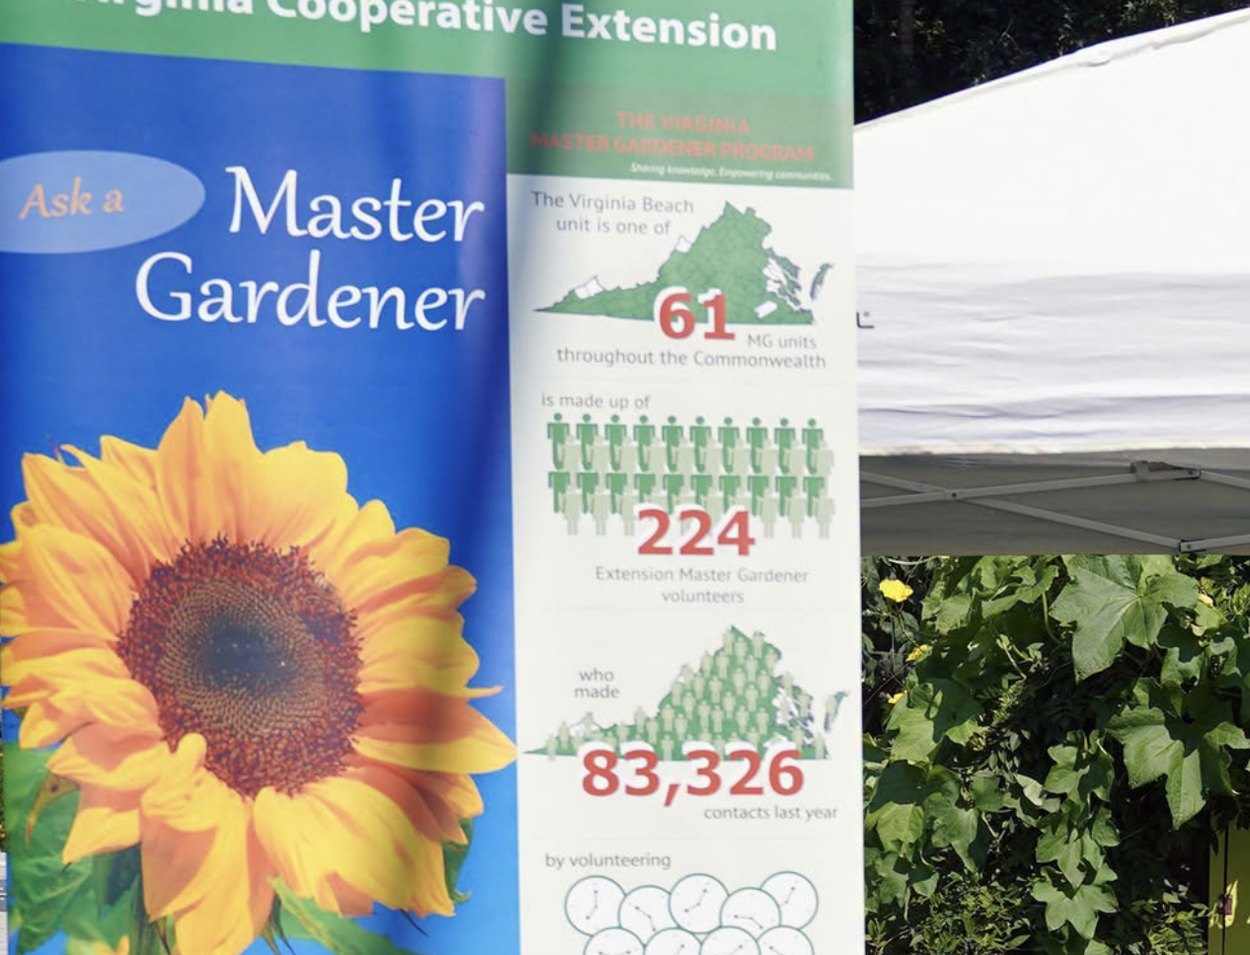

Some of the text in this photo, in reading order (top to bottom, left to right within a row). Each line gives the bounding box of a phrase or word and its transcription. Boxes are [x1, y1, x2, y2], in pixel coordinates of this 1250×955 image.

[561, 4, 777, 50] Extension
[615, 111, 750, 135] THE VIRGINIA
[531, 133, 815, 162] MASTER GARDENER PROGRAM
[19, 176, 124, 220] Ask a
[225, 166, 485, 242] Master
[531, 190, 694, 216] The Virginia Beach
[556, 216, 671, 236] unit is one of
[136, 248, 486, 331] Gardener
[659, 292, 735, 340] 61
[748, 334, 817, 350] MG units
[557, 347, 826, 369] throughout the Commonwealth
[541, 393, 651, 411] is made up of
[637, 508, 756, 557] 224
[595, 565, 810, 584] Extension Master Gardener
[661, 589, 745, 604] volunteers
[578, 667, 615, 682] who
[574, 684, 620, 699] made
[582, 749, 804, 807] 83,326
[703, 804, 838, 823] contacts last year
[545, 853, 672, 870] by volunteering
